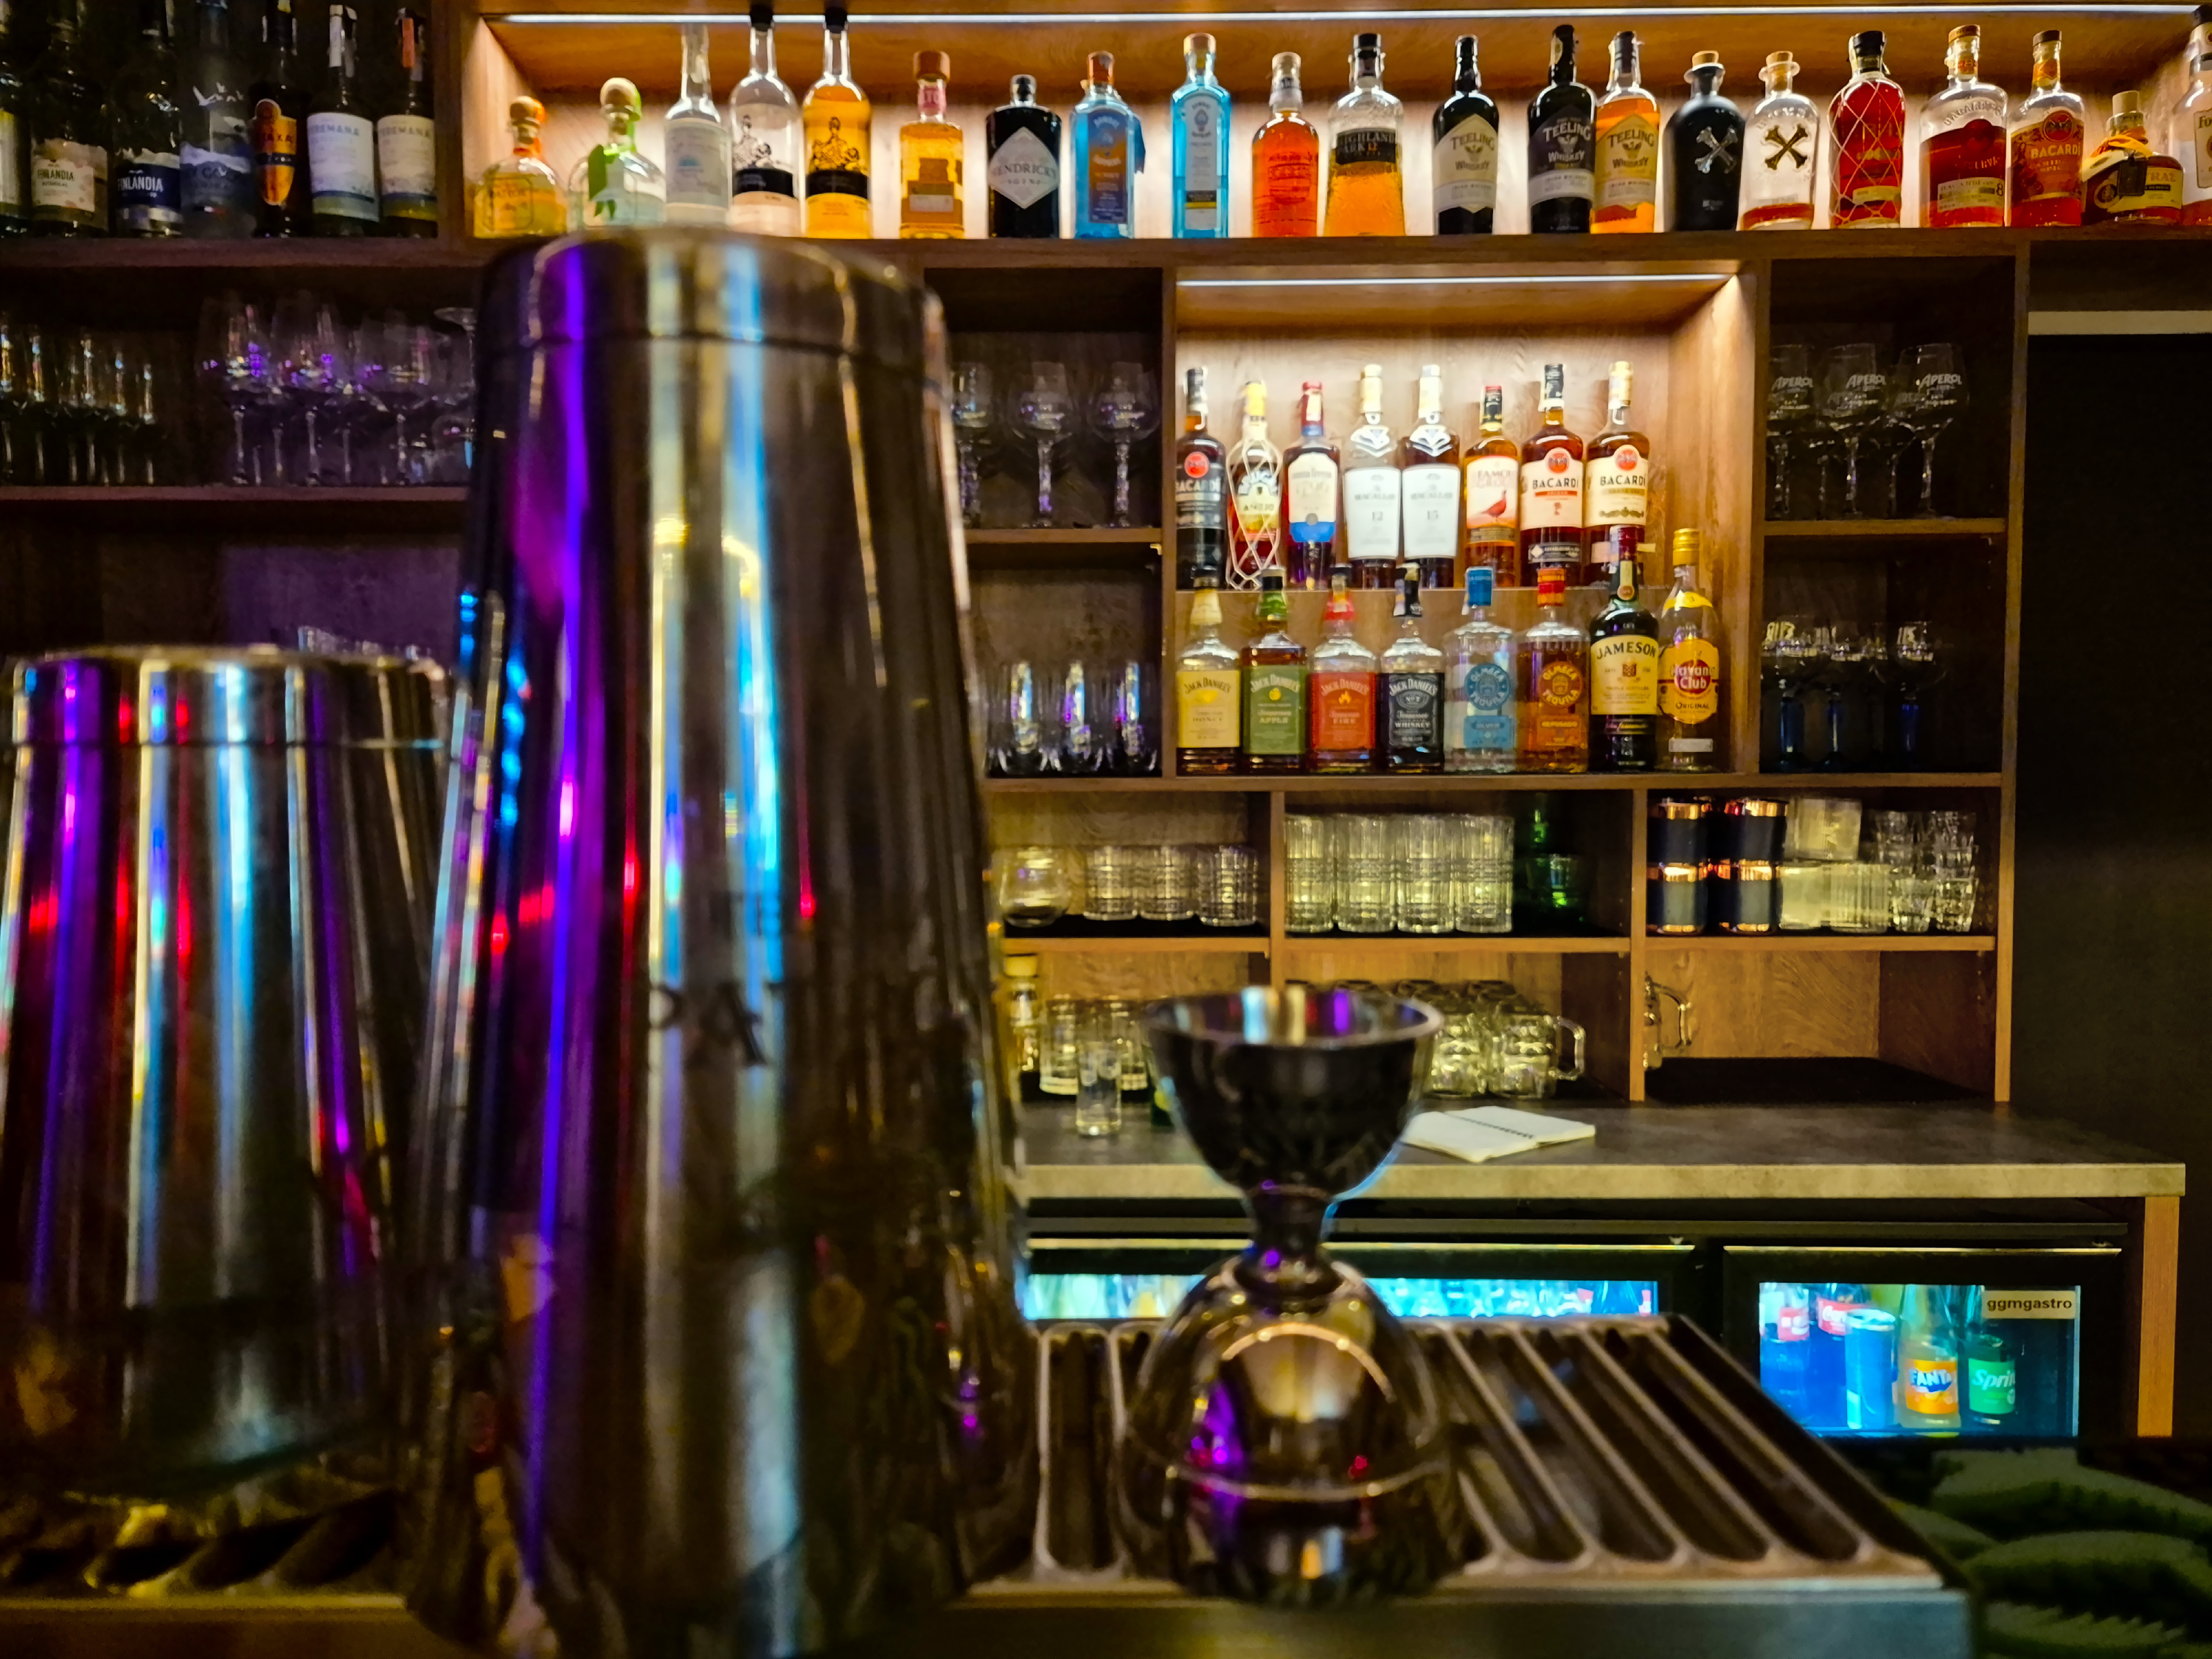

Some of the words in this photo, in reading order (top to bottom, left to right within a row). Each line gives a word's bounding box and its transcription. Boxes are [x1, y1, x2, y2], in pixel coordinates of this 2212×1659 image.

[2198, 116, 2212, 129] Fo
[1543, 122, 1590, 142] TEELING
[1607, 129, 1654, 148] TEELING
[1450, 132, 1495, 151] TEELING
[117, 175, 164, 192] FINLANDIA
[1919, 374, 1962, 392] APEROL
[1596, 641, 1657, 660] JAMESON
[1470, 667, 1506, 683] OLMECA
[1542, 665, 1578, 681] OLMECA
[1389, 681, 1407, 697] JACK
[1680, 678, 1707, 689] Club
[1470, 692, 1506, 706] TEQUILA
[1543, 689, 1579, 706] TEQUILA
[1987, 1298, 2072, 1311] ggmgastro
[1972, 1369, 2016, 1391] Sprit
